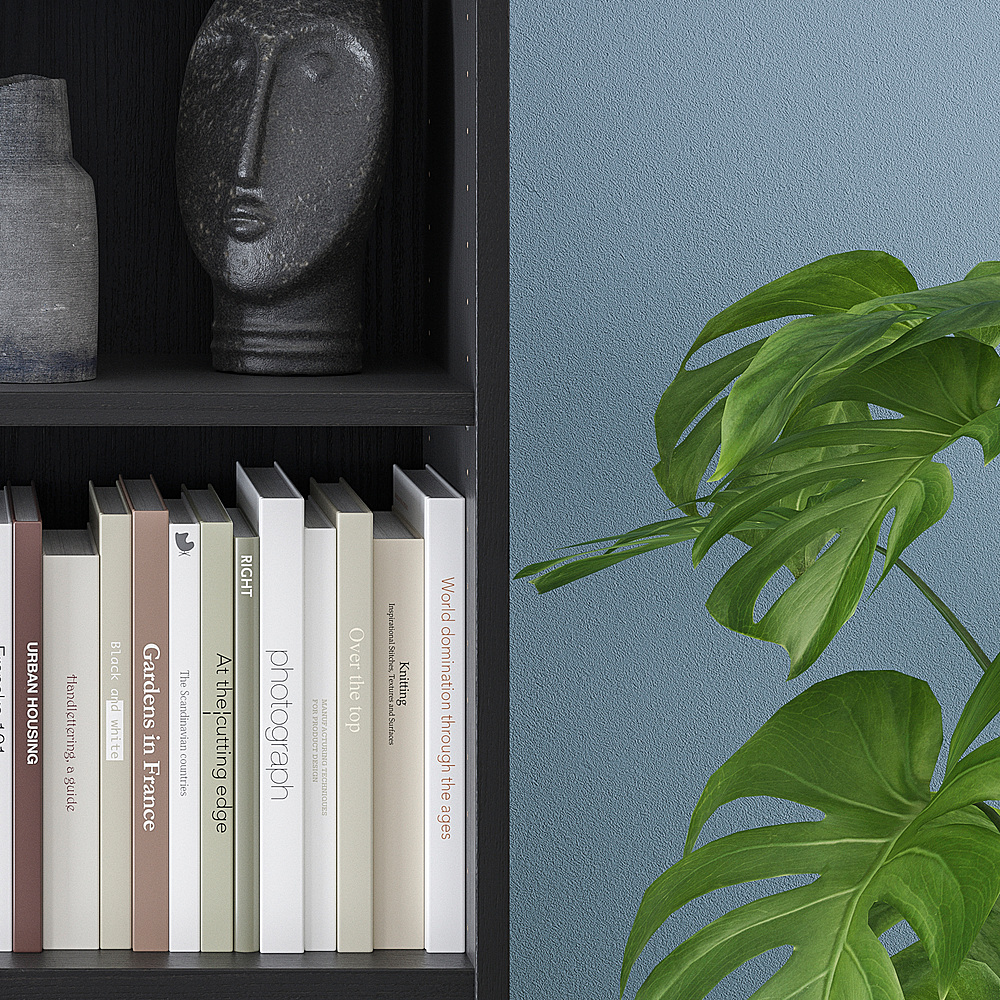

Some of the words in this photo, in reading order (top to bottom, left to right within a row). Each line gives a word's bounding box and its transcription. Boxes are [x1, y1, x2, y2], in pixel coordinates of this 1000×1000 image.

[240, 555, 253, 598] RIGHT
[440, 576, 455, 622] World
[386, 603, 396, 645] Inspirational
[27, 641, 39, 694] URBAN
[110, 641, 121, 681] Black
[216, 653, 232, 675] At
[348, 627, 365, 670] Over
[387, 646, 396, 673] Stitches,
[440, 626, 455, 710] domination
[143, 642, 161, 729] Gardens
[179, 670, 190, 688] The
[215, 680, 233, 710] the
[348, 675, 365, 701] the
[388, 674, 396, 703] Textures
[396, 661, 410, 707] Knitting
[110, 688, 121, 712] and
[345, 706, 363, 734] top
[388, 703, 396, 716] and
[27, 697, 39, 765] HOUSING
[110, 719, 121, 759] white
[179, 690, 190, 751] Scandinavian
[264, 650, 294, 801] photograph
[388, 717, 396, 746] Surfaces
[143, 734, 161, 755] in
[212, 716, 232, 780] cutting
[437, 714, 455, 773] through
[66, 766, 74, 774] a
[179, 753, 190, 797] countries
[440, 777, 455, 801] the
[63, 777, 78, 812] guide
[143, 760, 161, 832] France
[211, 785, 233, 834] edge
[437, 805, 451, 840] ages
